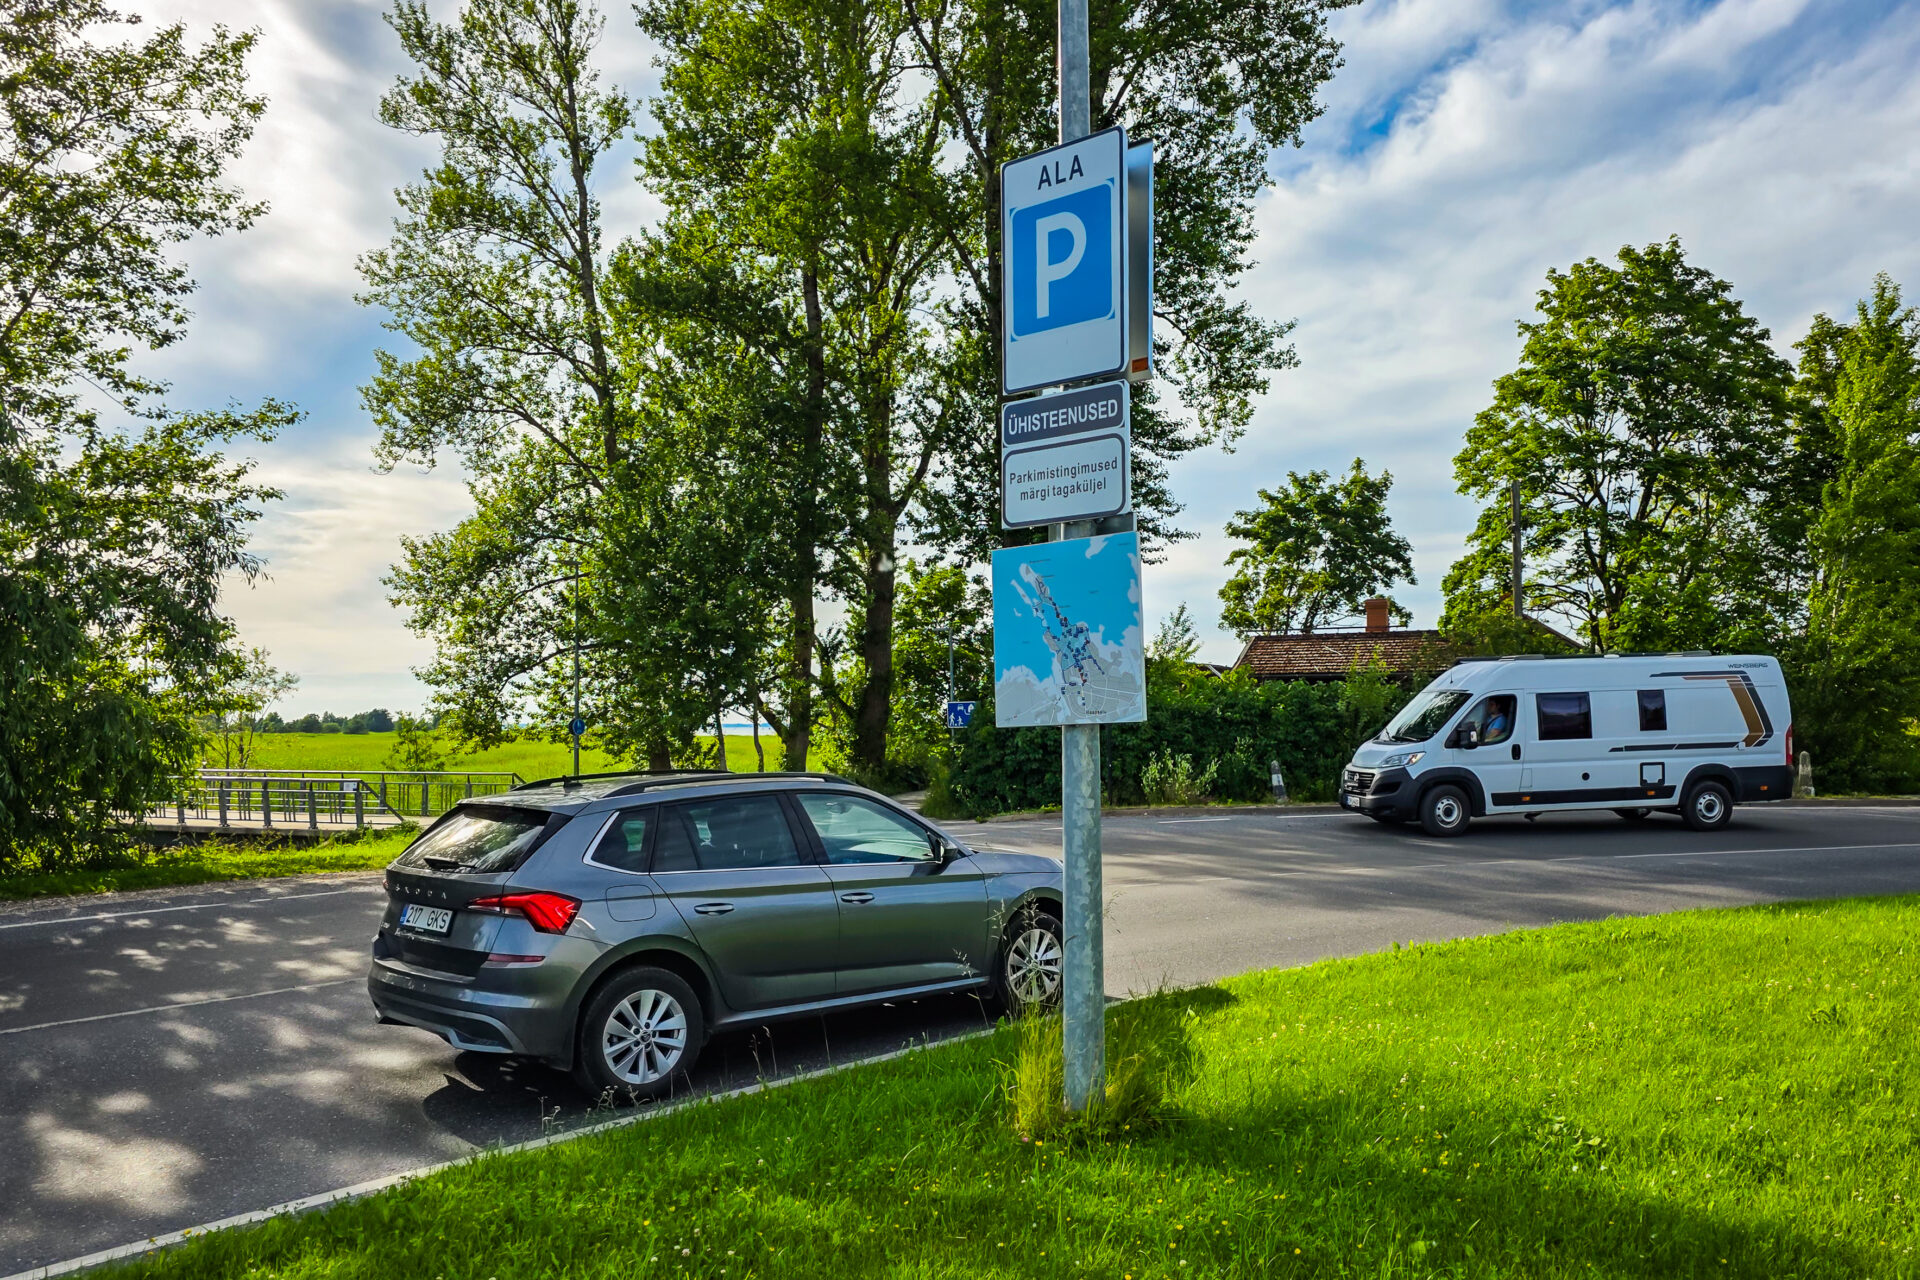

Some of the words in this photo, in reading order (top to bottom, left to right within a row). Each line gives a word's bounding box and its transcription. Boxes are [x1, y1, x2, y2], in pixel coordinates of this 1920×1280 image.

[1037, 154, 1084, 191] ALA
[1035, 211, 1087, 320] P
[1008, 399, 1118, 435] ÜHISTEENUSED
[1009, 456, 1118, 485] Parkimistingimused
[1020, 485, 1050, 501] märgi
[1052, 476, 1107, 498] tagaküljel
[406, 906, 423, 925] 217
[426, 910, 449, 930] GKS
